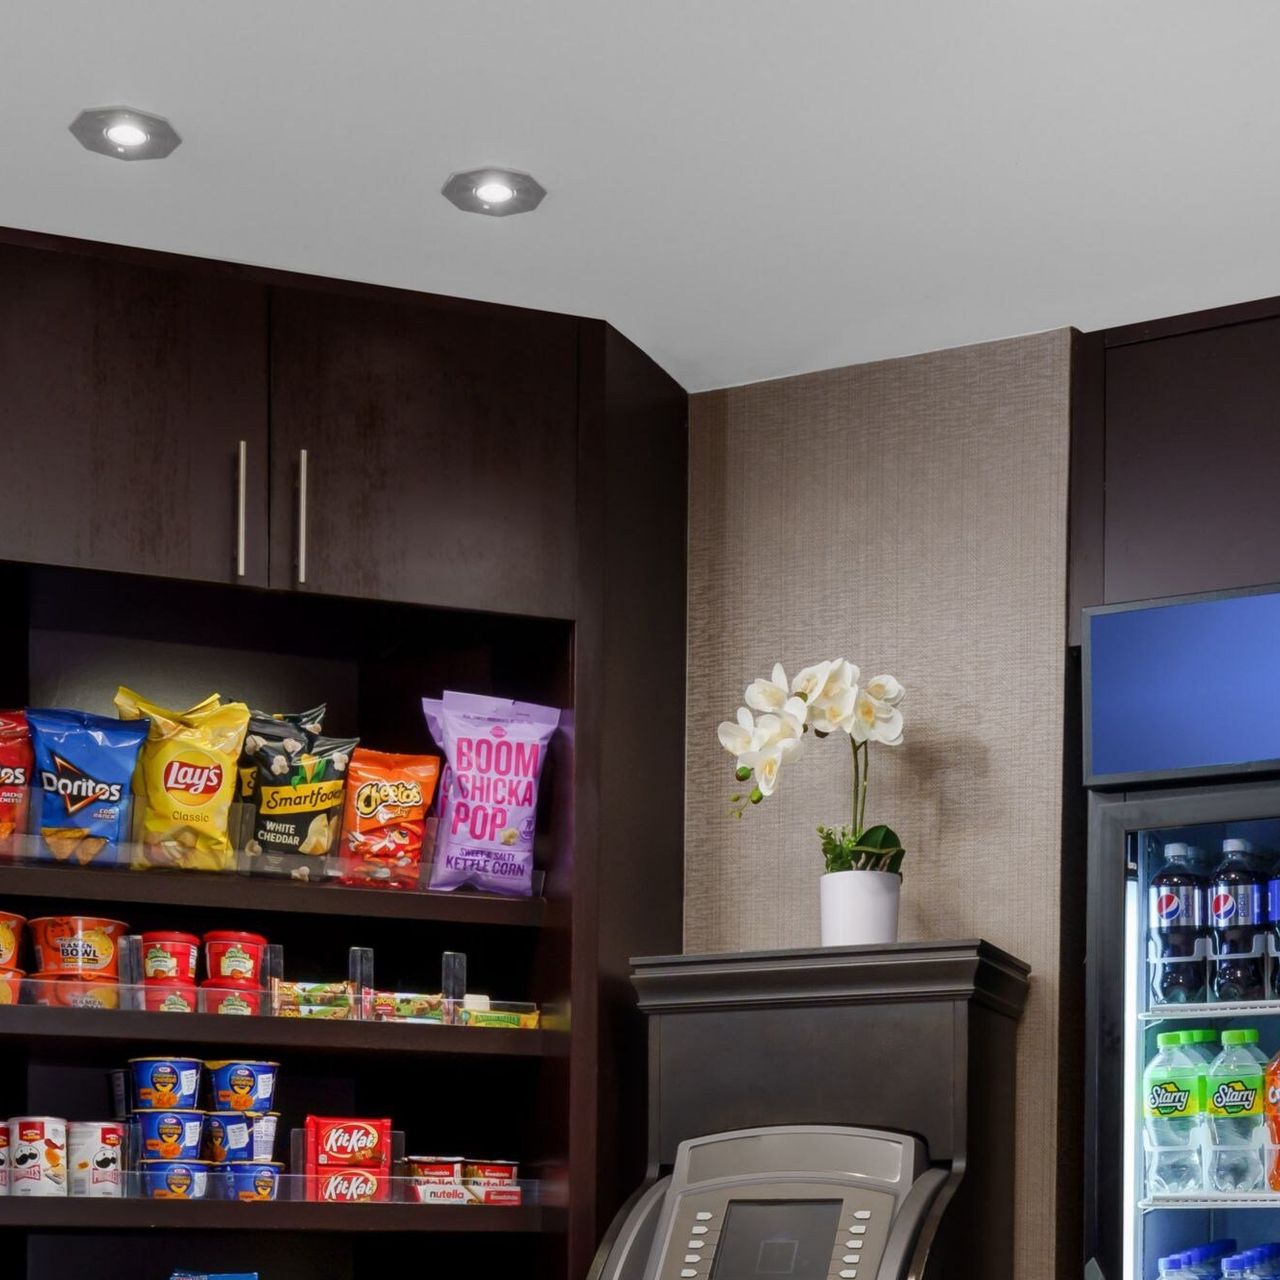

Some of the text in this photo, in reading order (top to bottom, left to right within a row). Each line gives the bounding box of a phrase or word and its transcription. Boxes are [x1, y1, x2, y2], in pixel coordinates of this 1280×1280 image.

[456, 737, 540, 778] BOOM
[41, 771, 121, 801] Doritos
[167, 761, 221, 793] Lay's
[357, 782, 422, 816] Cheetos
[456, 773, 533, 807] CHICKA
[172, 811, 210, 823] Classic
[266, 821, 297, 834] WHITE
[451, 801, 507, 841] POP
[257, 830, 300, 846] CHEDDAR
[446, 855, 525, 877] KETTLE CORN
[61, 948, 99, 957] BOWL
[1150, 1085, 1190, 1110] Starry
[1213, 1085, 1257, 1110] Starry
[429, 1189, 464, 1199] nutella
